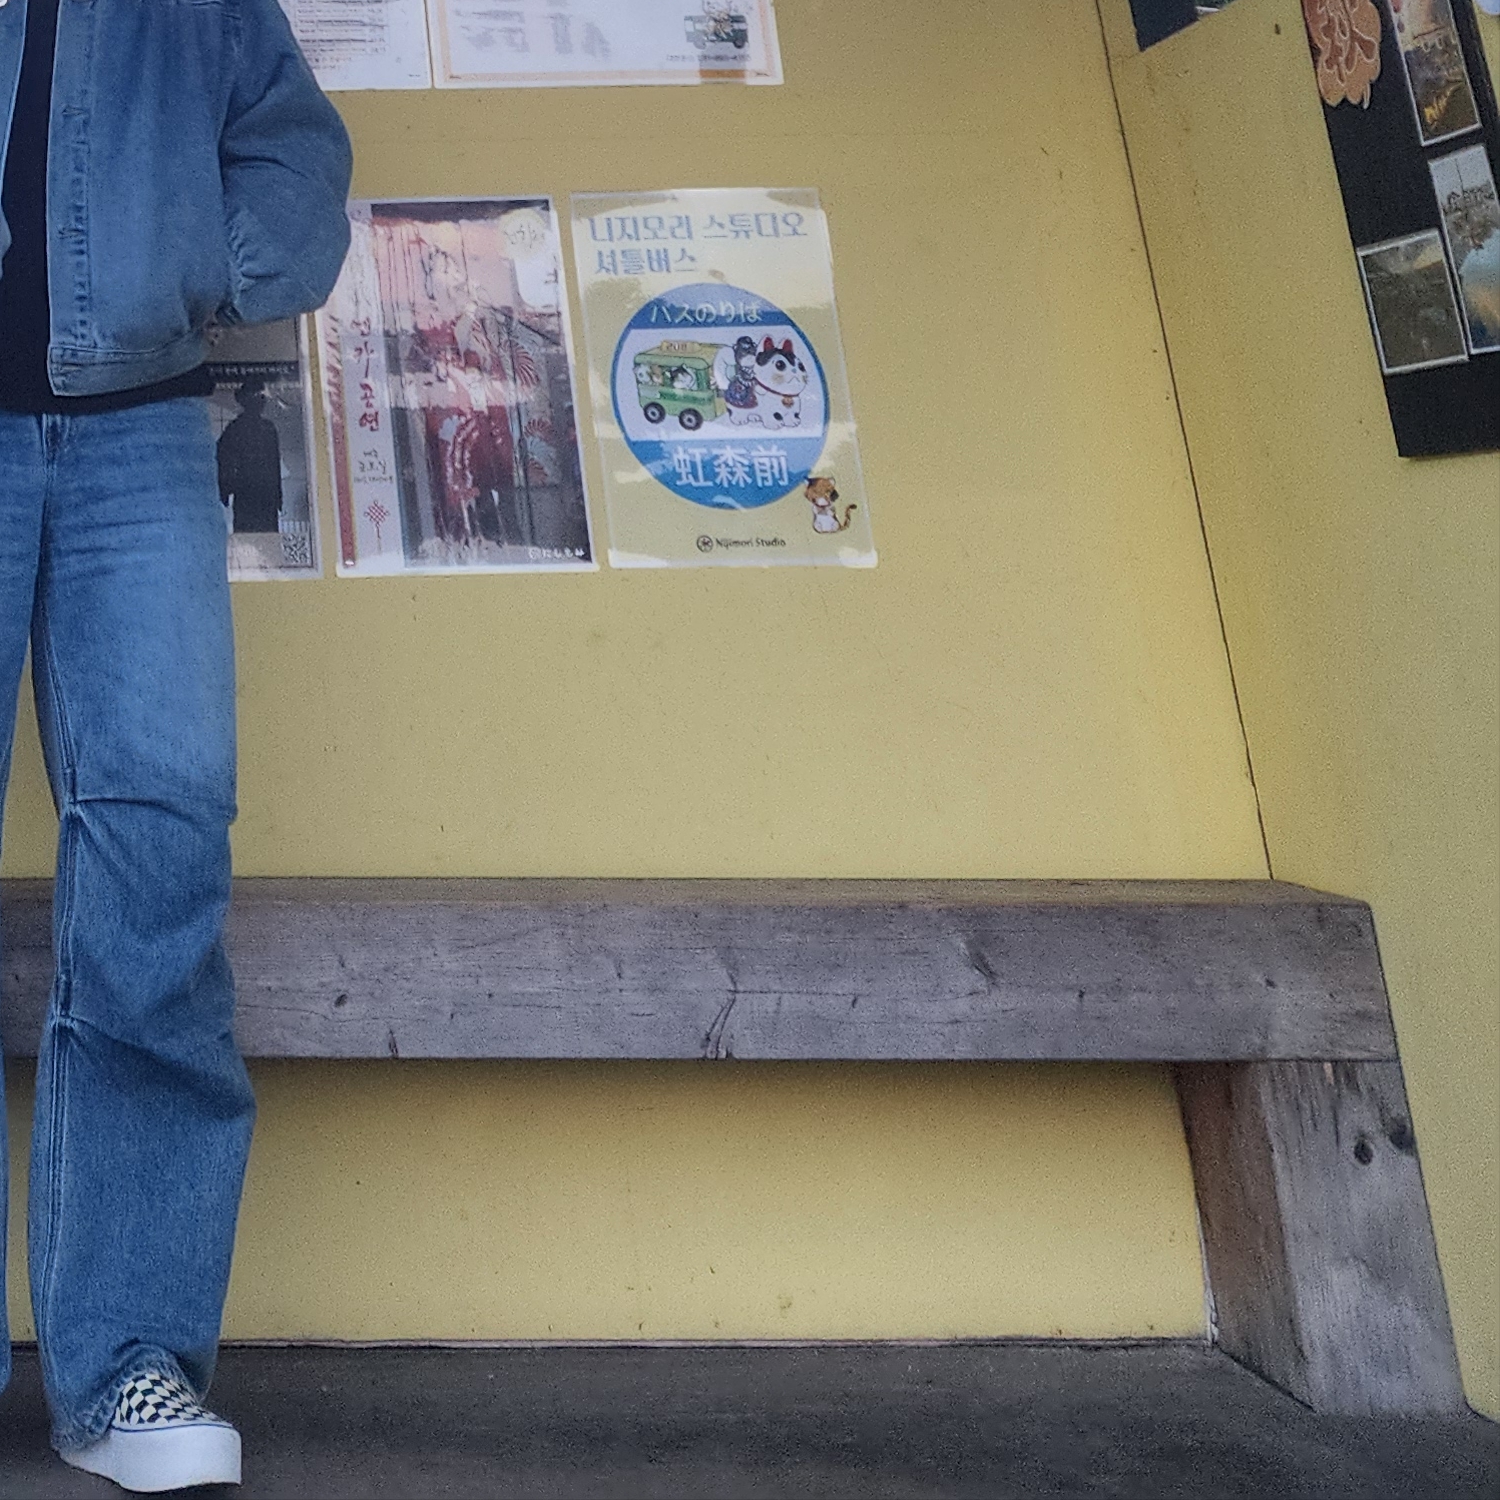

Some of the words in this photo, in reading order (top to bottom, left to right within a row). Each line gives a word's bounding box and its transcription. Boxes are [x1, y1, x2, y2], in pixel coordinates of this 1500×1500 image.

[588, 214, 694, 242] 니지모리
[703, 212, 808, 240] 스튜디오
[595, 247, 699, 276] 셔틀버스
[672, 445, 789, 487] 虹森前
[755, 536, 786, 547] Studio
